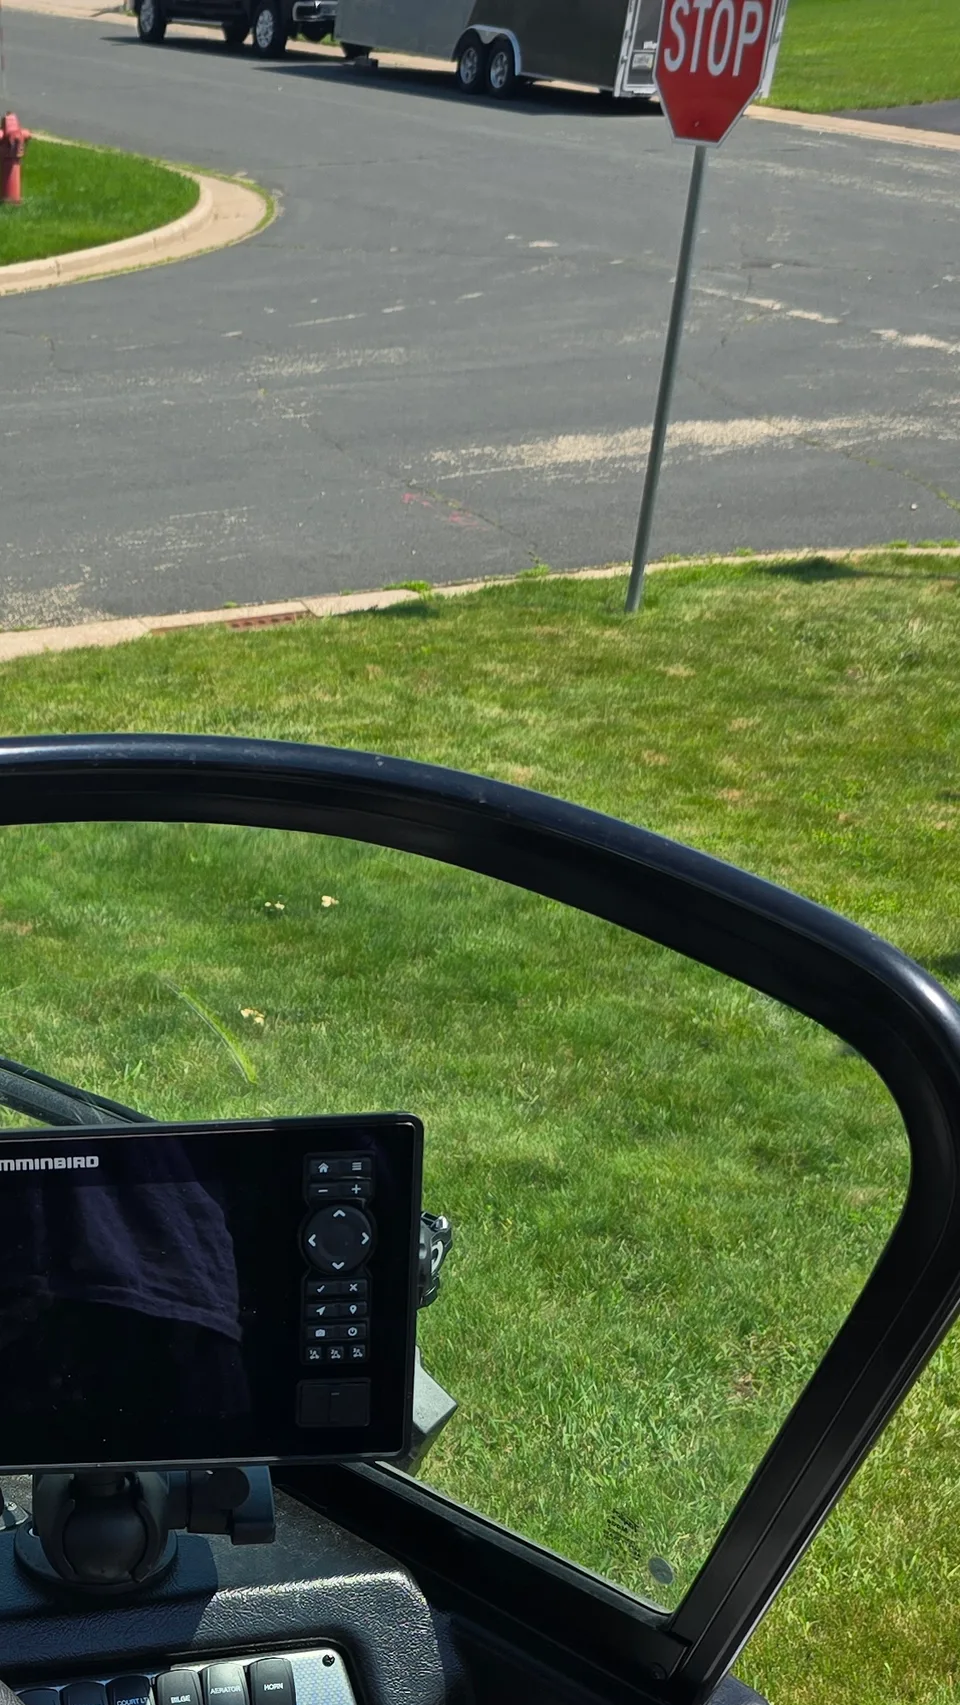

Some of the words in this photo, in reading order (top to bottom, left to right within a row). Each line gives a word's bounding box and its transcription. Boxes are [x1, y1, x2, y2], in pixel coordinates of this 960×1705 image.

[663, 0, 763, 77] STOP
[210, 1685, 242, 1696] AERATOR
[263, 1682, 285, 1692] HORN
